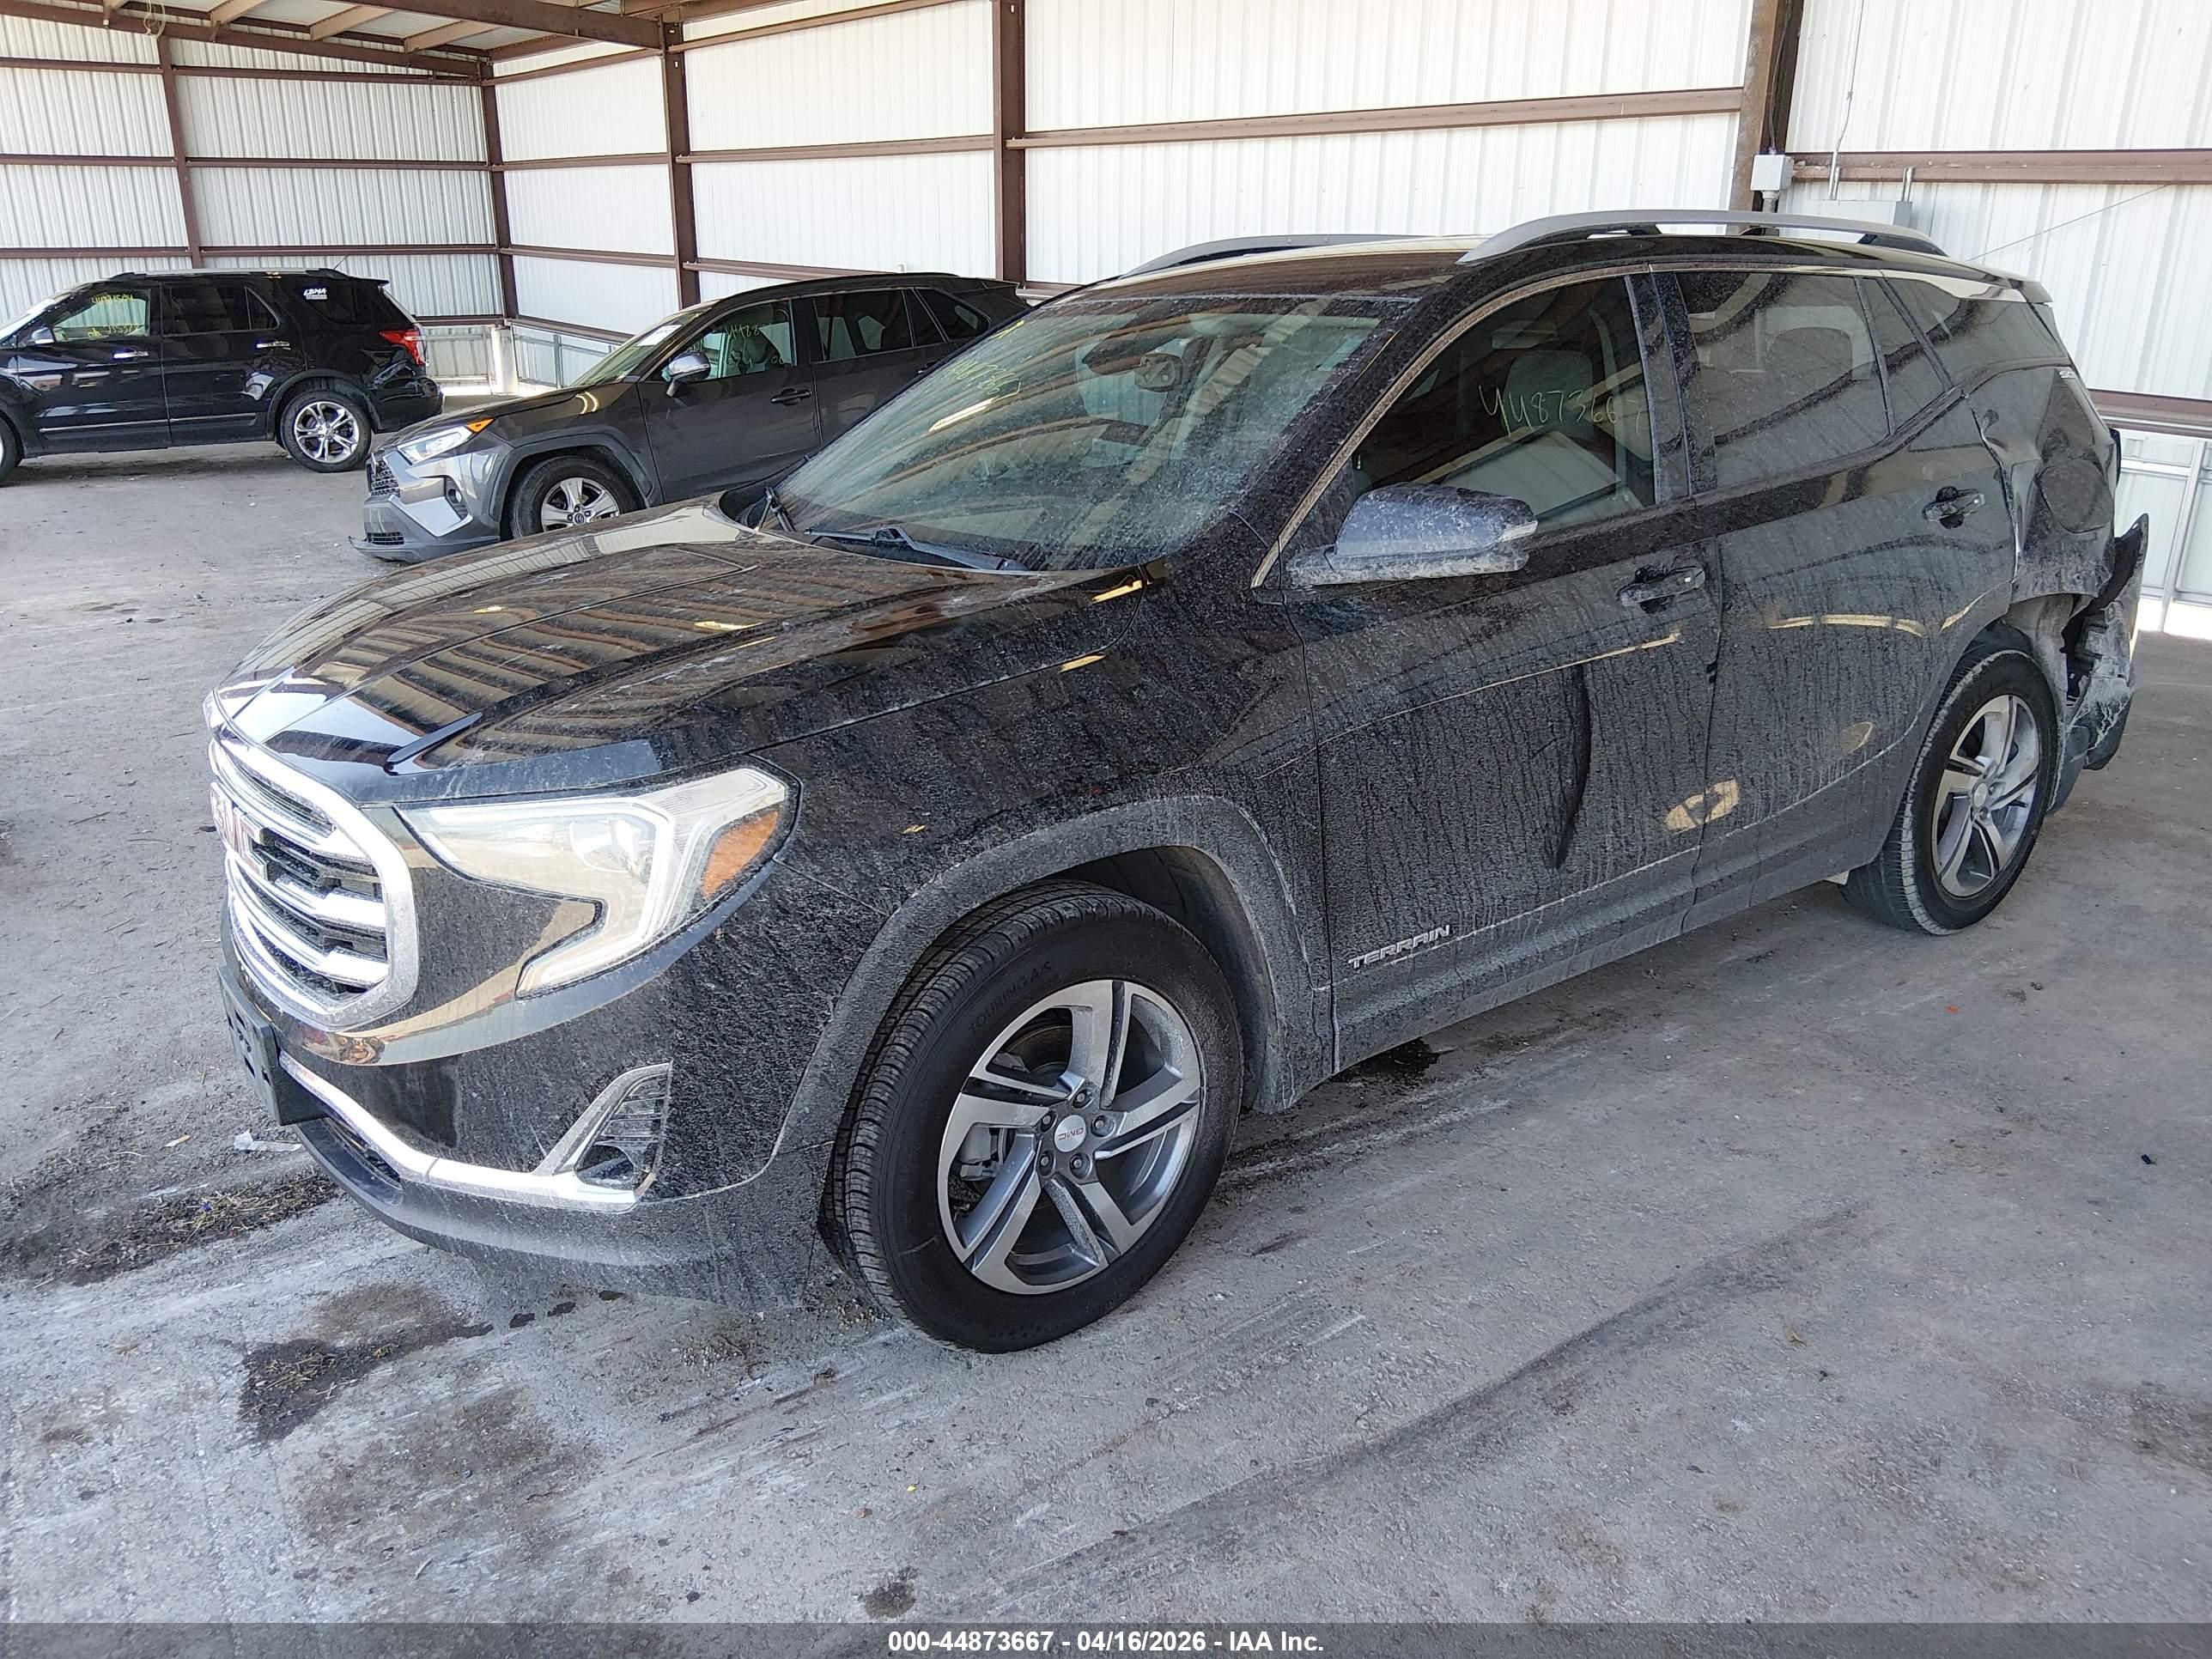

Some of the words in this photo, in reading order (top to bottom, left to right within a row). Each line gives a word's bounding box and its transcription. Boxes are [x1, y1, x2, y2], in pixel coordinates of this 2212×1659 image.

[1478, 385, 1644, 437] 44873667
[1347, 924, 1450, 969] TERRAIN
[1057, 1127, 1085, 1141] GMC
